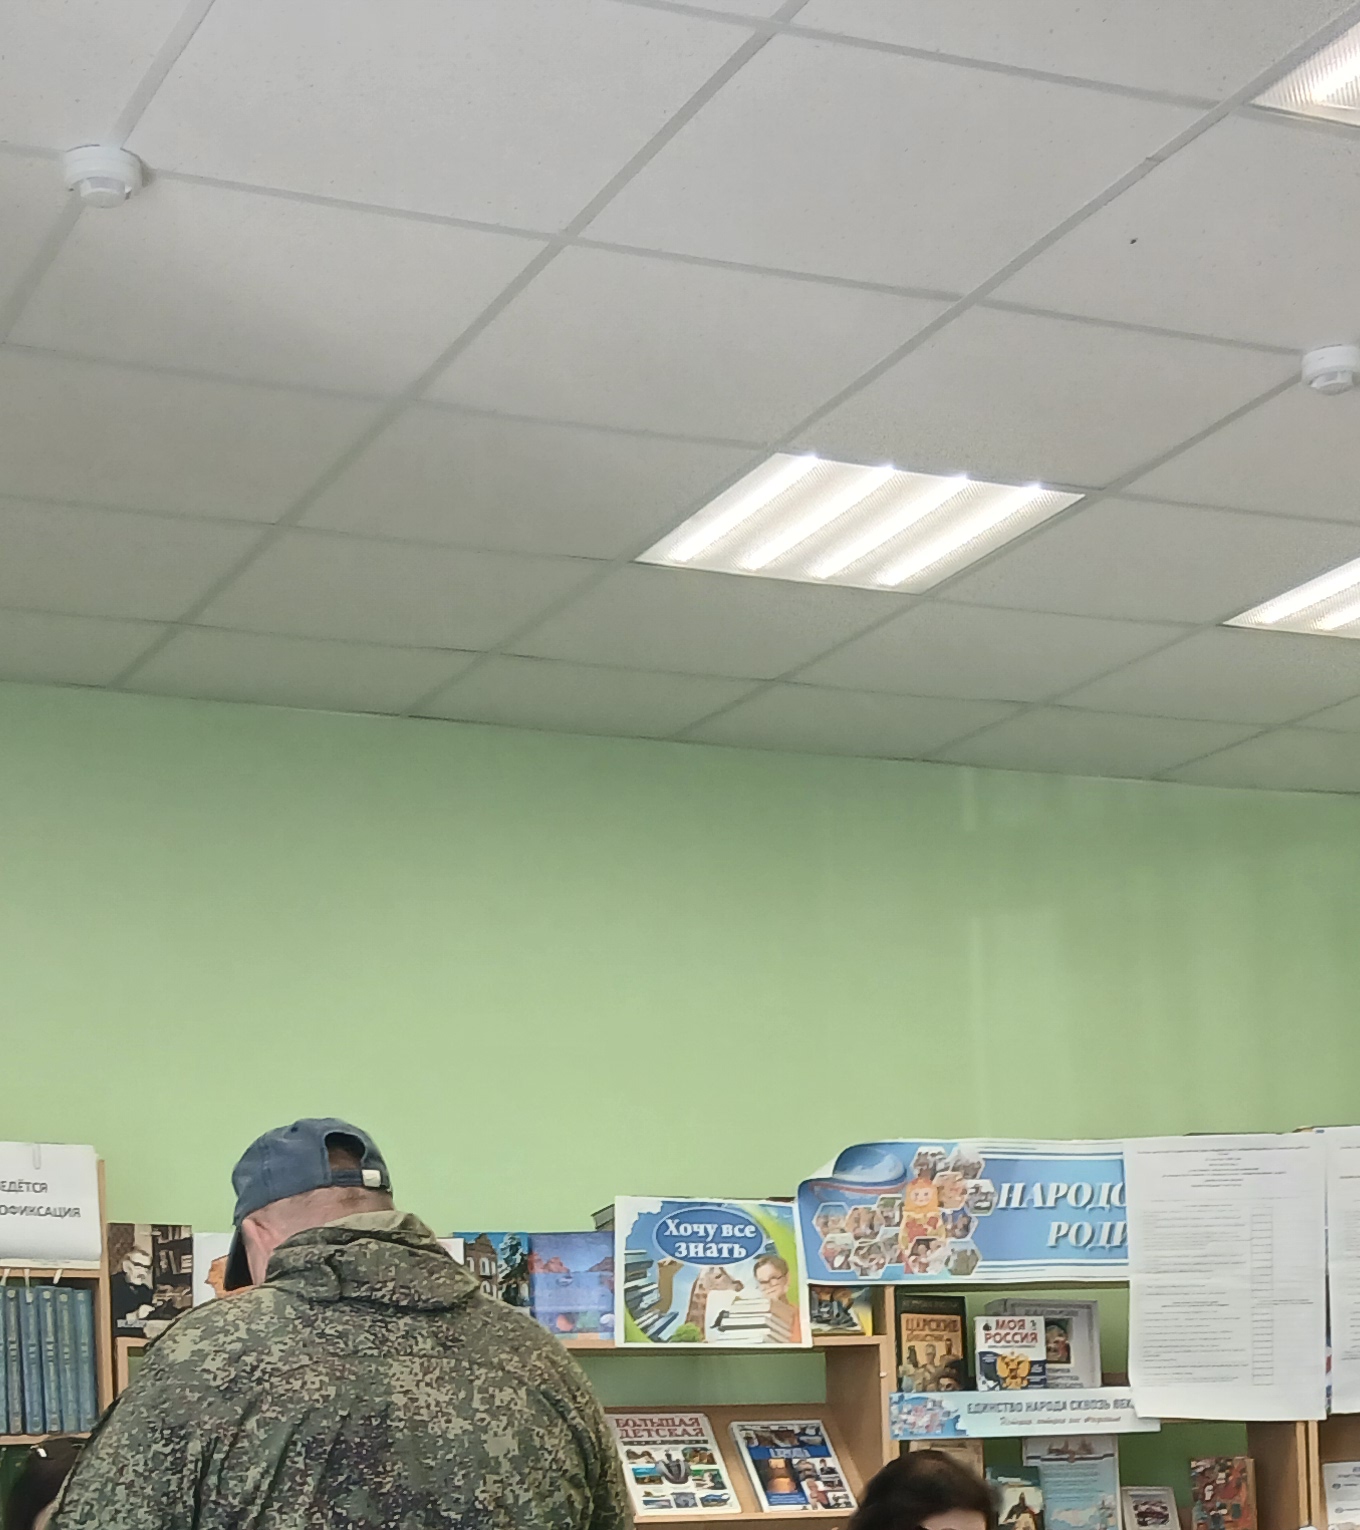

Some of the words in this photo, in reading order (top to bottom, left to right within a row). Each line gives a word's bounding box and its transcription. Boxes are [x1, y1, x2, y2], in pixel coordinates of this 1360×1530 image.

[664, 1217, 718, 1244] Хочу
[721, 1223, 757, 1238] все
[674, 1241, 747, 1259] знать
[995, 1319, 1026, 1331] МОЯ
[985, 1332, 1038, 1344] РОССИЯ
[615, 1418, 700, 1428] БОЛЬШАЯ
[620, 1428, 705, 1439] ДЕТСКАЯ
